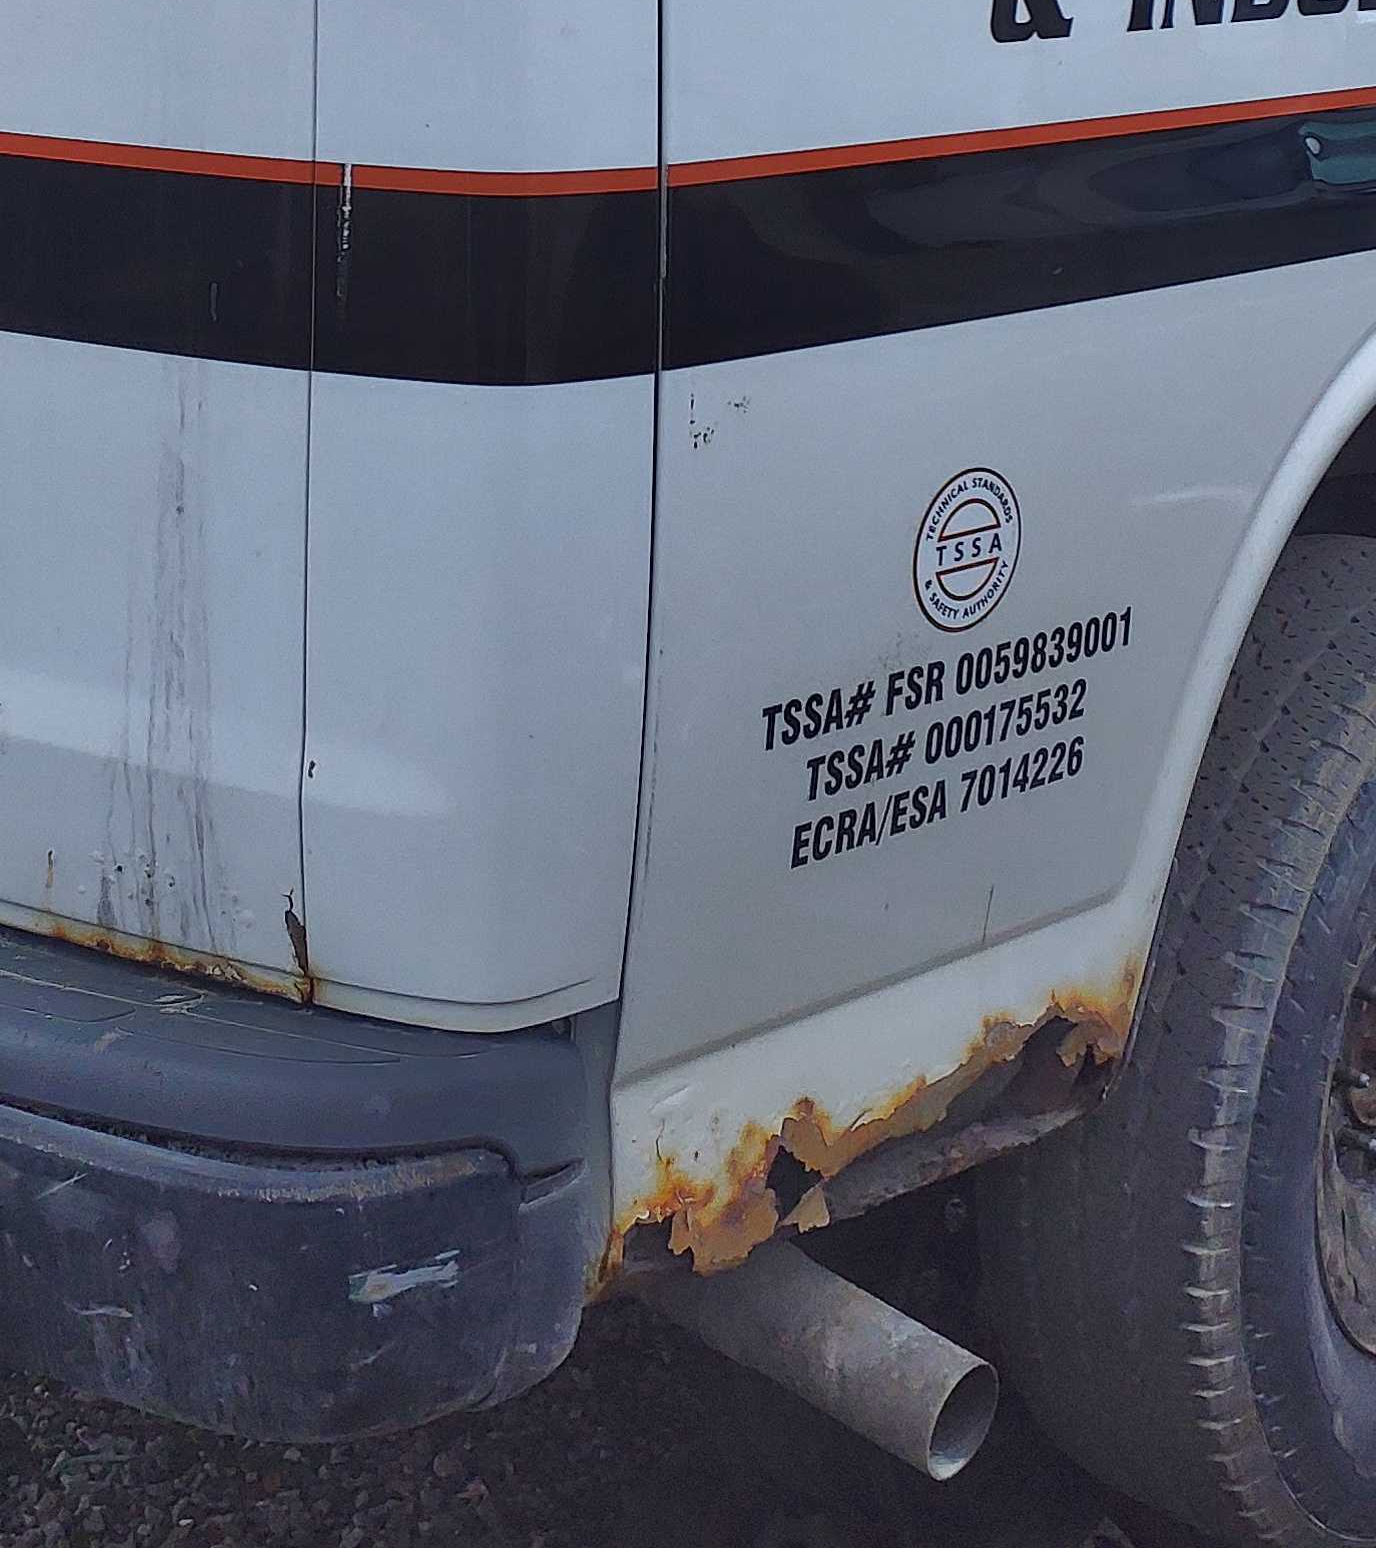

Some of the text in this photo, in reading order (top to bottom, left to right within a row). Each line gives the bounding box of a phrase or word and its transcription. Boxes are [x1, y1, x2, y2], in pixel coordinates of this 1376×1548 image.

[926, 477, 1013, 541] TECHNICAL STANDARDS
[929, 592, 959, 619] SAFETY
[962, 560, 1009, 619] AUTHORITY
[762, 606, 1133, 751] TSSA# FSR 0059839001
[806, 679, 1087, 801] TSSA# 000175532
[790, 736, 1084, 869] ECRA/ESA 7014226
